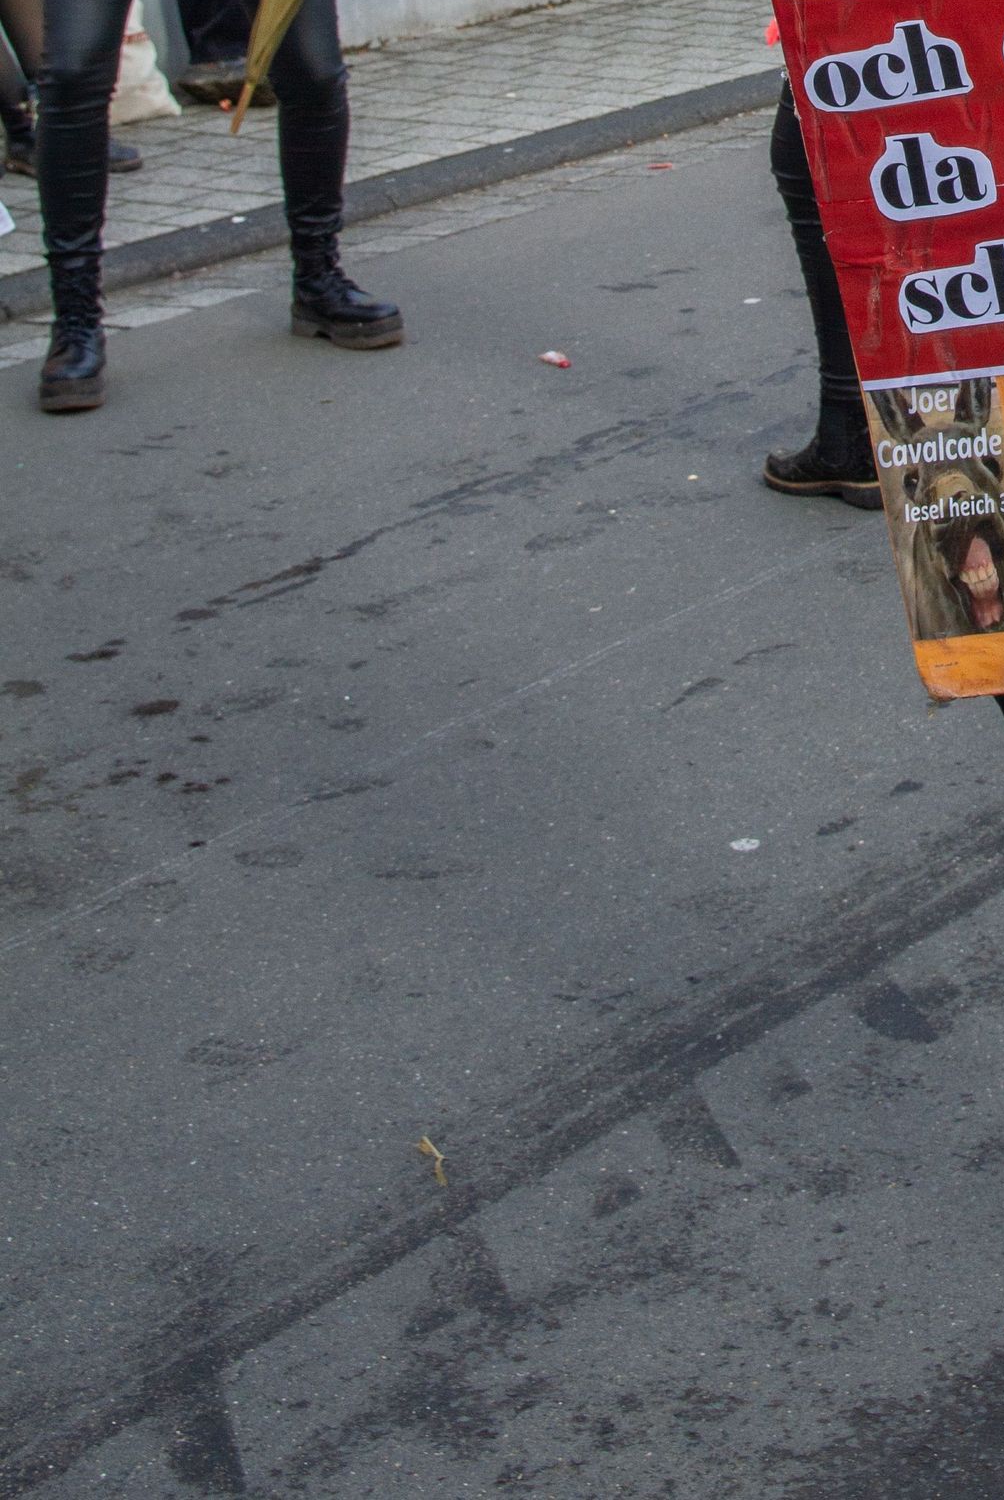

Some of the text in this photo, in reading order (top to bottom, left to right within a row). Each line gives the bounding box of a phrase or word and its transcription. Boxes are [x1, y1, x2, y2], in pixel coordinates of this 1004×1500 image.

[812, 25, 968, 107] och
[878, 137, 989, 210] da
[908, 387, 960, 415] Joer
[877, 428, 1002, 468] Cavalcade
[950, 493, 995, 518] heich
